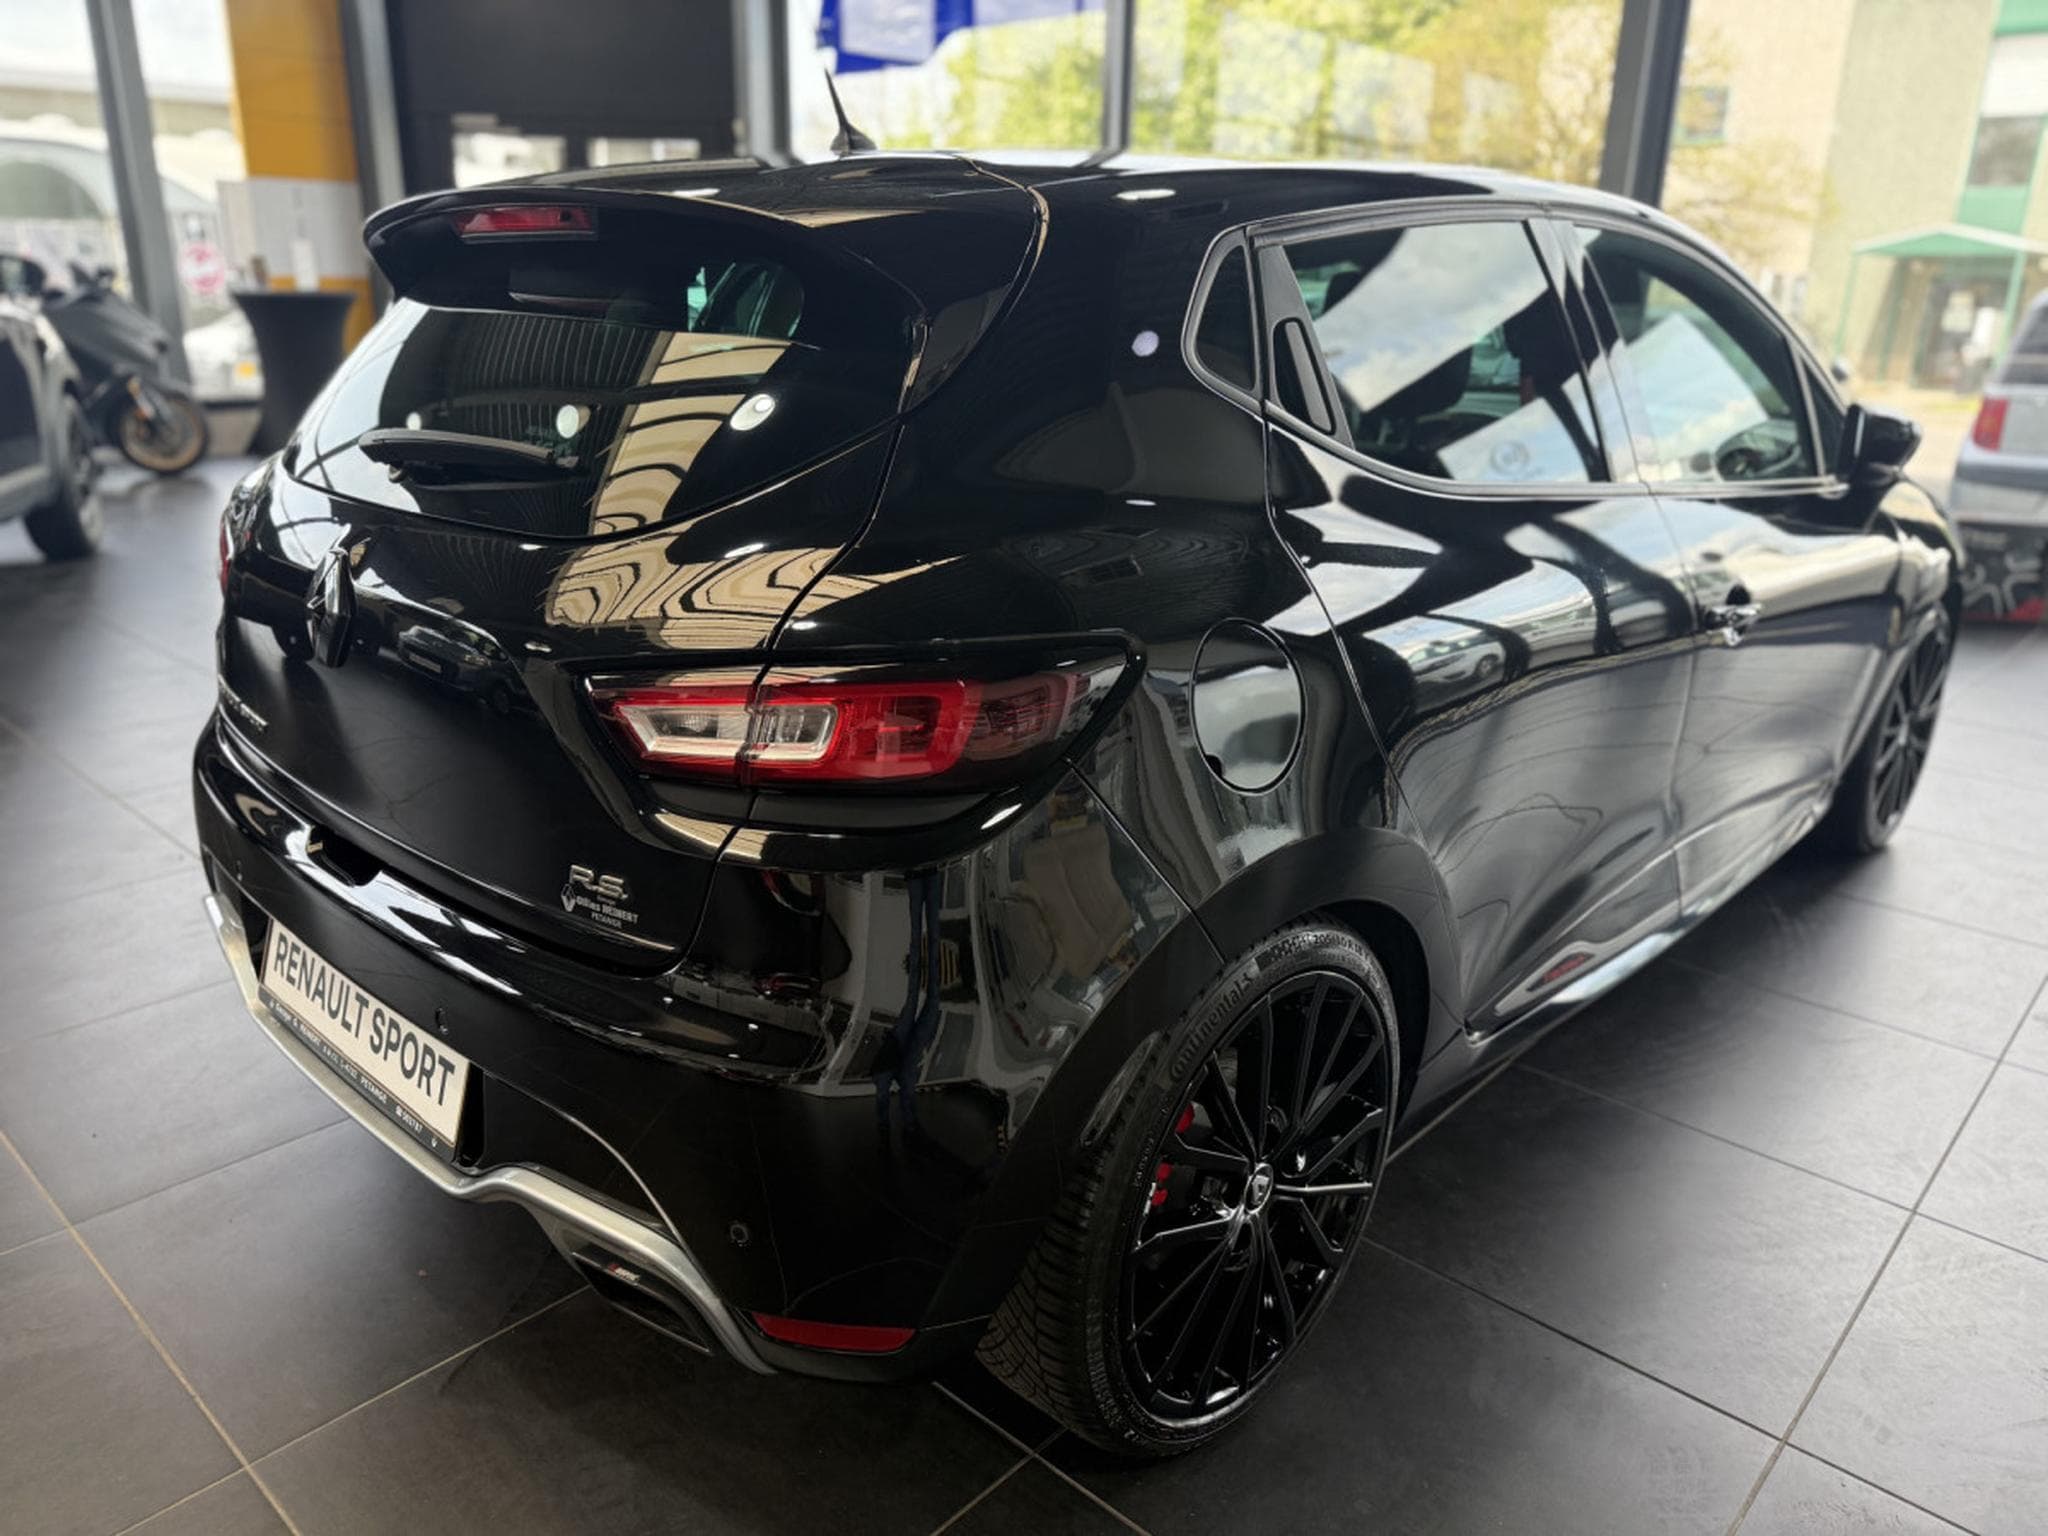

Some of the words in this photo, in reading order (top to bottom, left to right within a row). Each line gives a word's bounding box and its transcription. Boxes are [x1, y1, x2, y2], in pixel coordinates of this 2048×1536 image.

[273, 932, 369, 1039] RENAULT
[369, 1007, 455, 1106] SPORT
[1169, 979, 1245, 1081] Continental
